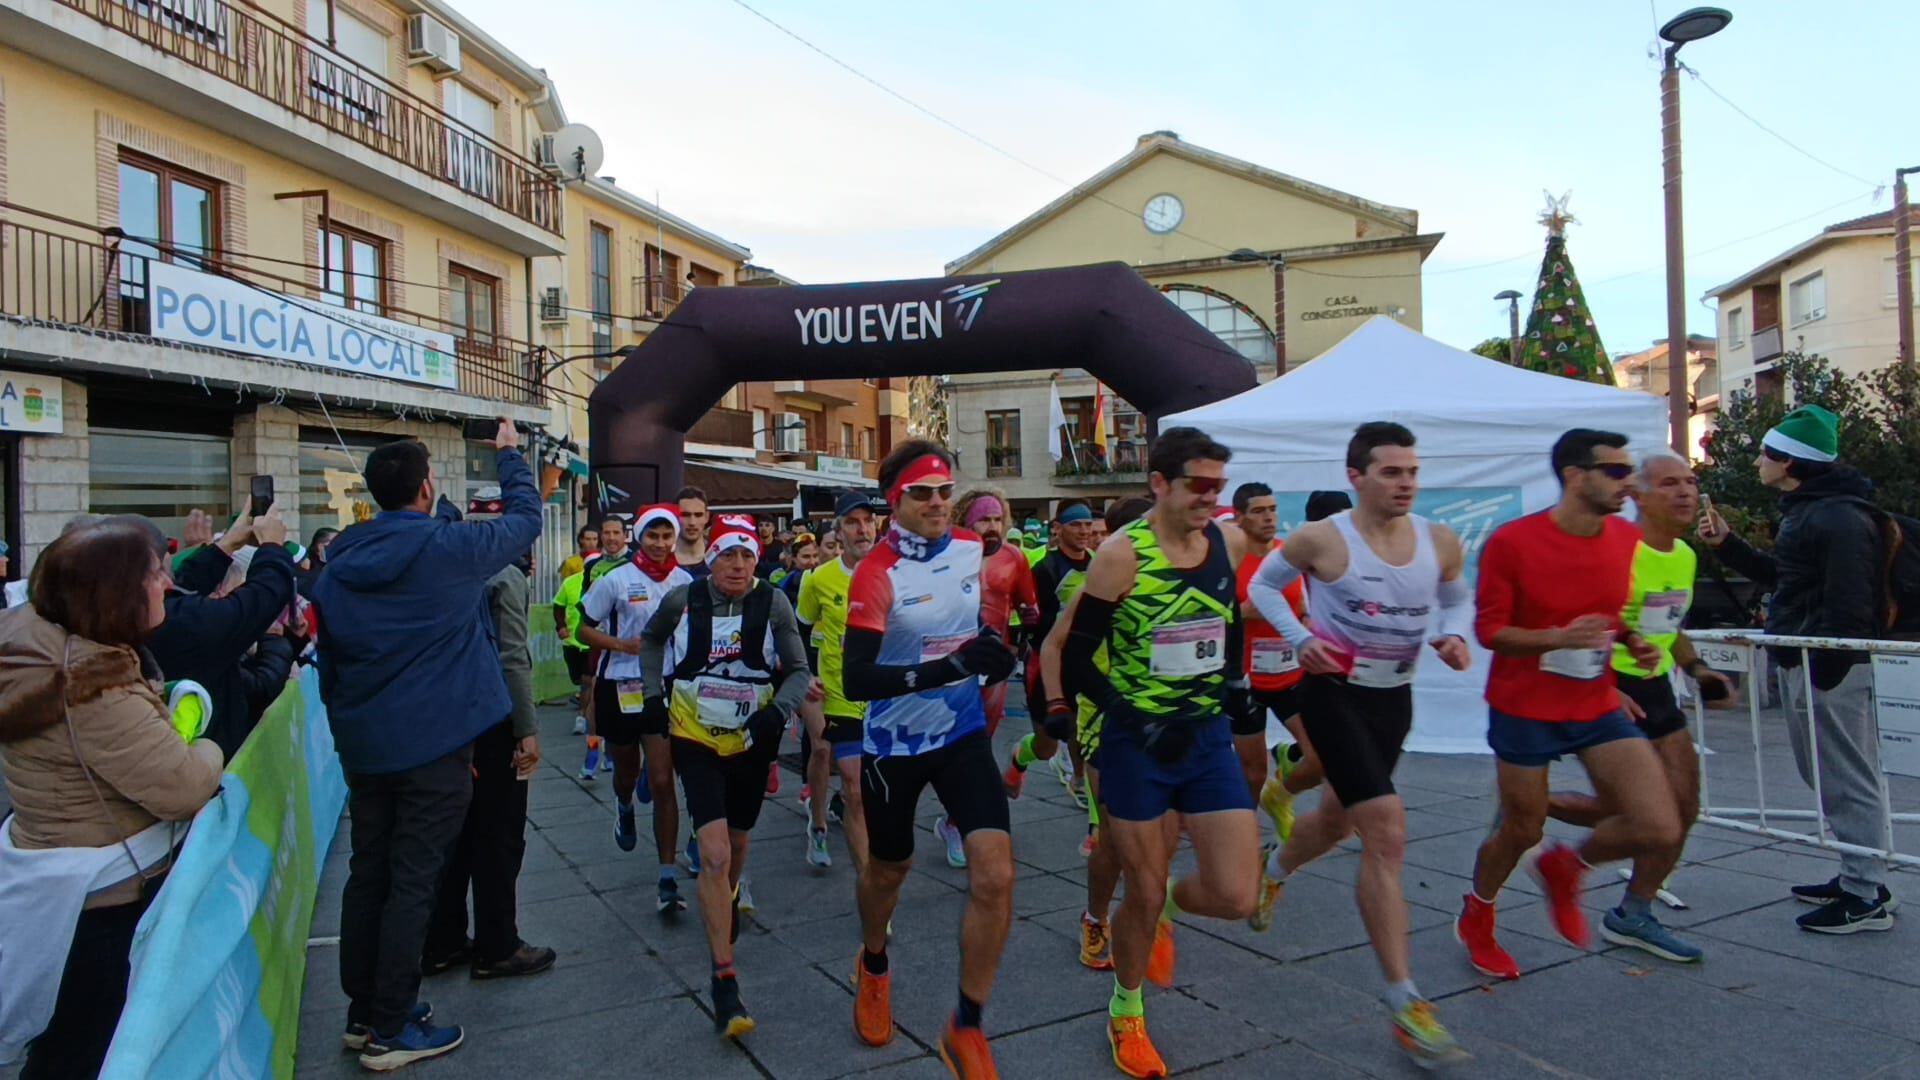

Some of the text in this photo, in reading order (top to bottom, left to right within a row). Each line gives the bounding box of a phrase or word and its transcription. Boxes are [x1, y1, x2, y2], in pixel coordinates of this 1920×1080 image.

[1324, 295, 1358, 307] CASA
[794, 300, 943, 345] YOU EVEN
[1300, 306, 1384, 321] CONSISTORIAL
[156, 285, 315, 357] POLICÍA
[326, 323, 421, 377] LOCAL
[1195, 640, 1217, 660] 80
[735, 701, 750, 717] 70
